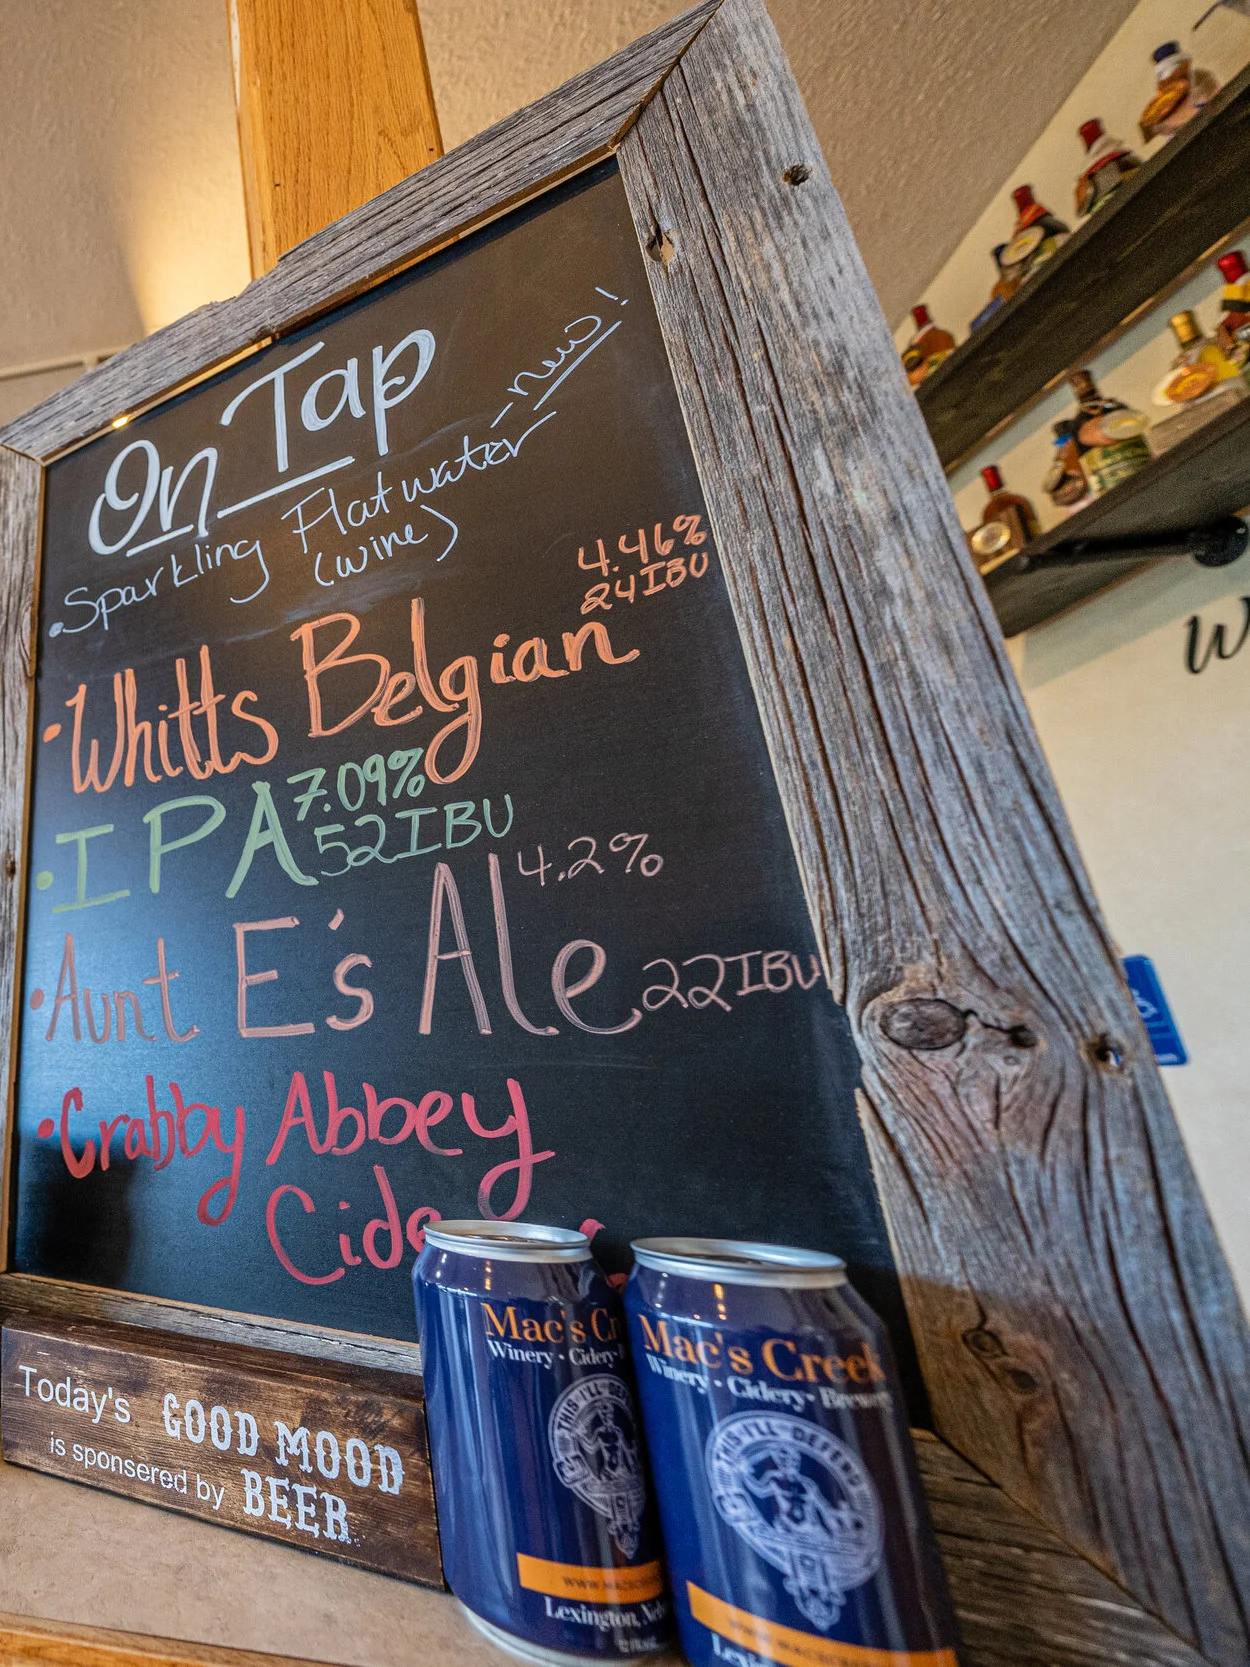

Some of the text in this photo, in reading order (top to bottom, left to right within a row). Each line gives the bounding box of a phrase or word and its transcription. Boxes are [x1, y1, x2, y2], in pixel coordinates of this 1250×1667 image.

[87, 328, 437, 556] On Tap
[314, 503, 459, 588] (wine)
[578, 514, 707, 577] 4.46%
[60, 538, 271, 635] Sparkling
[65, 597, 642, 794] Whitts Belgian
[286, 747, 425, 823] 7.09%
[516, 831, 664, 887] 4.2%
[47, 852, 643, 1044] Aunt E's Ale
[61, 1071, 556, 1227] Crabby Abbey
[479, 1302, 587, 1345] Mac's
[486, 1339, 615, 1370] Winery Cidery
[638, 1313, 754, 1375] Mac's
[557, 1398, 580, 1432] THIS
[645, 1352, 711, 1395] Winery
[726, 1374, 808, 1412] Cidery
[19, 1365, 406, 1496] Today's GOOD MOOD
[50, 1430, 352, 1546] is sponsered by BEER
